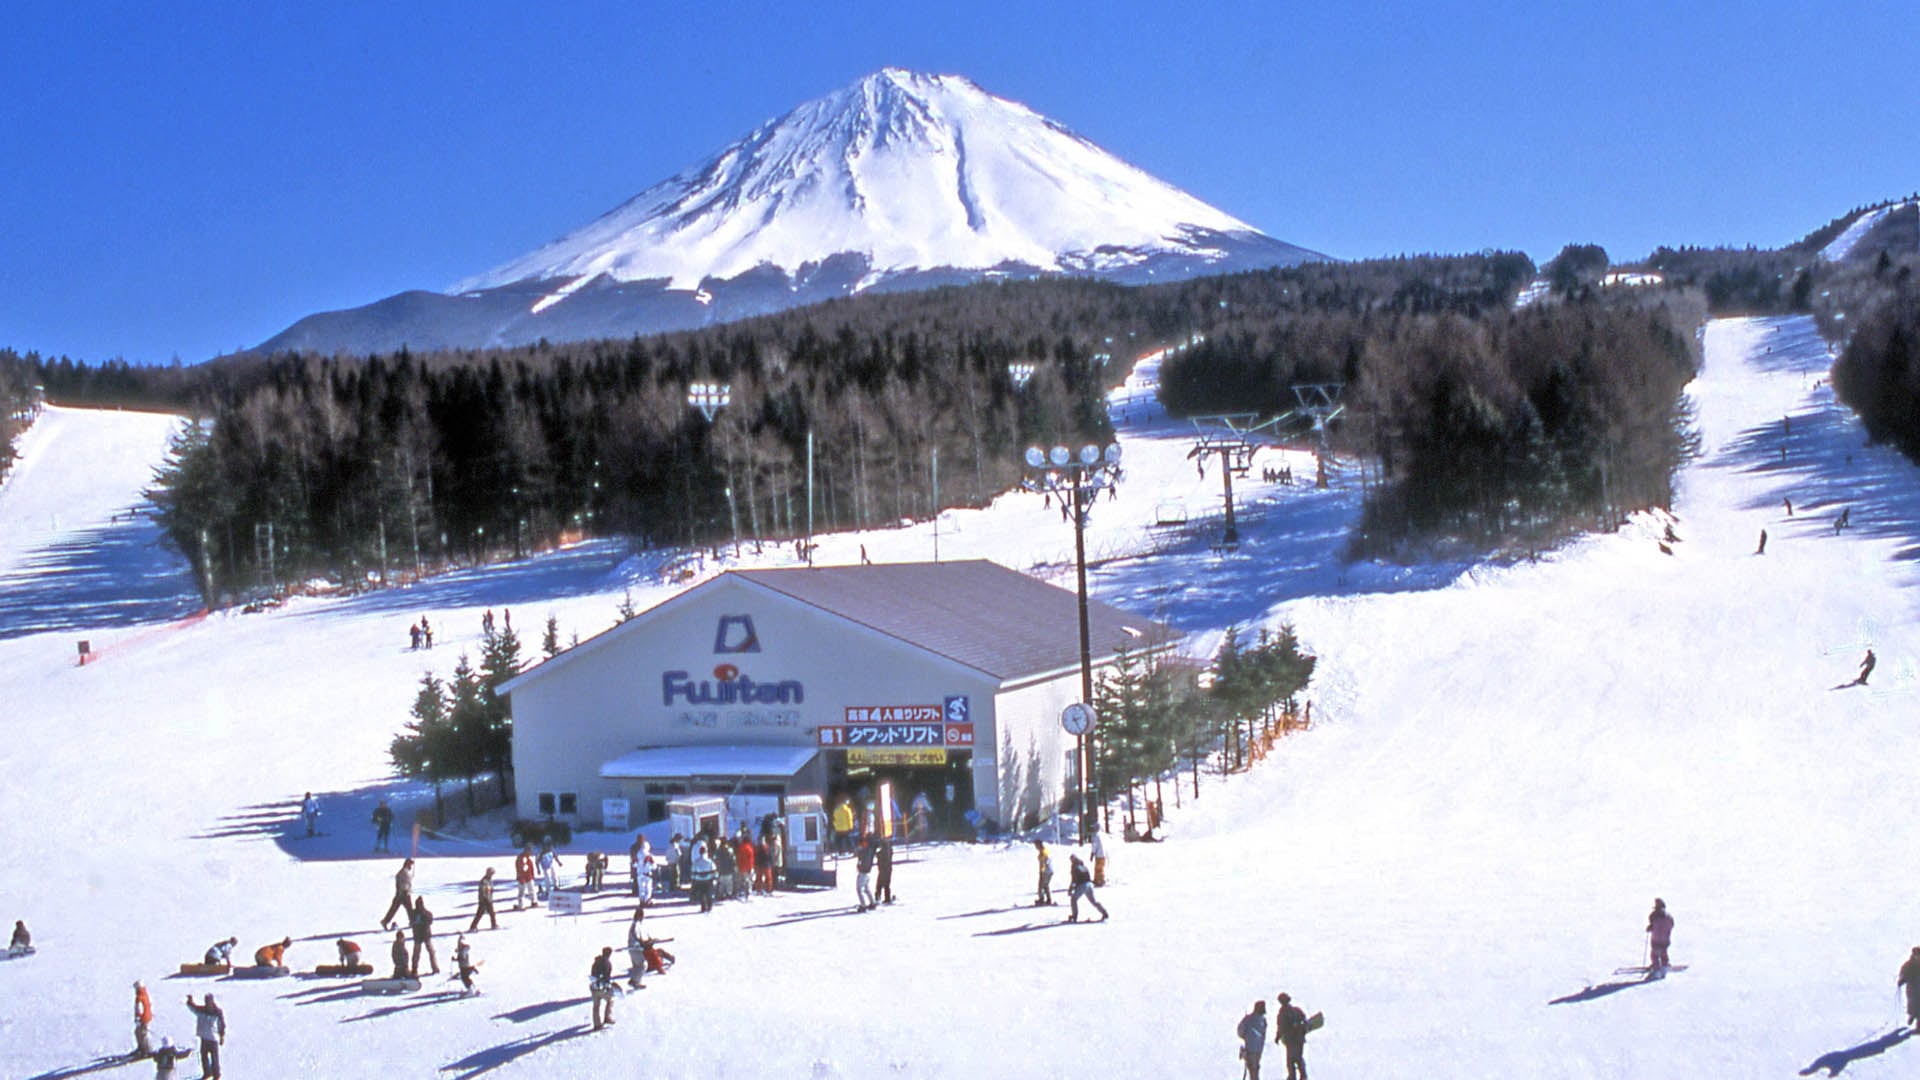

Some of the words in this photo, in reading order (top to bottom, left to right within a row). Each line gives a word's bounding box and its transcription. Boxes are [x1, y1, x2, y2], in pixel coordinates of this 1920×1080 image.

[850, 727, 938, 744] クワッドリフト
